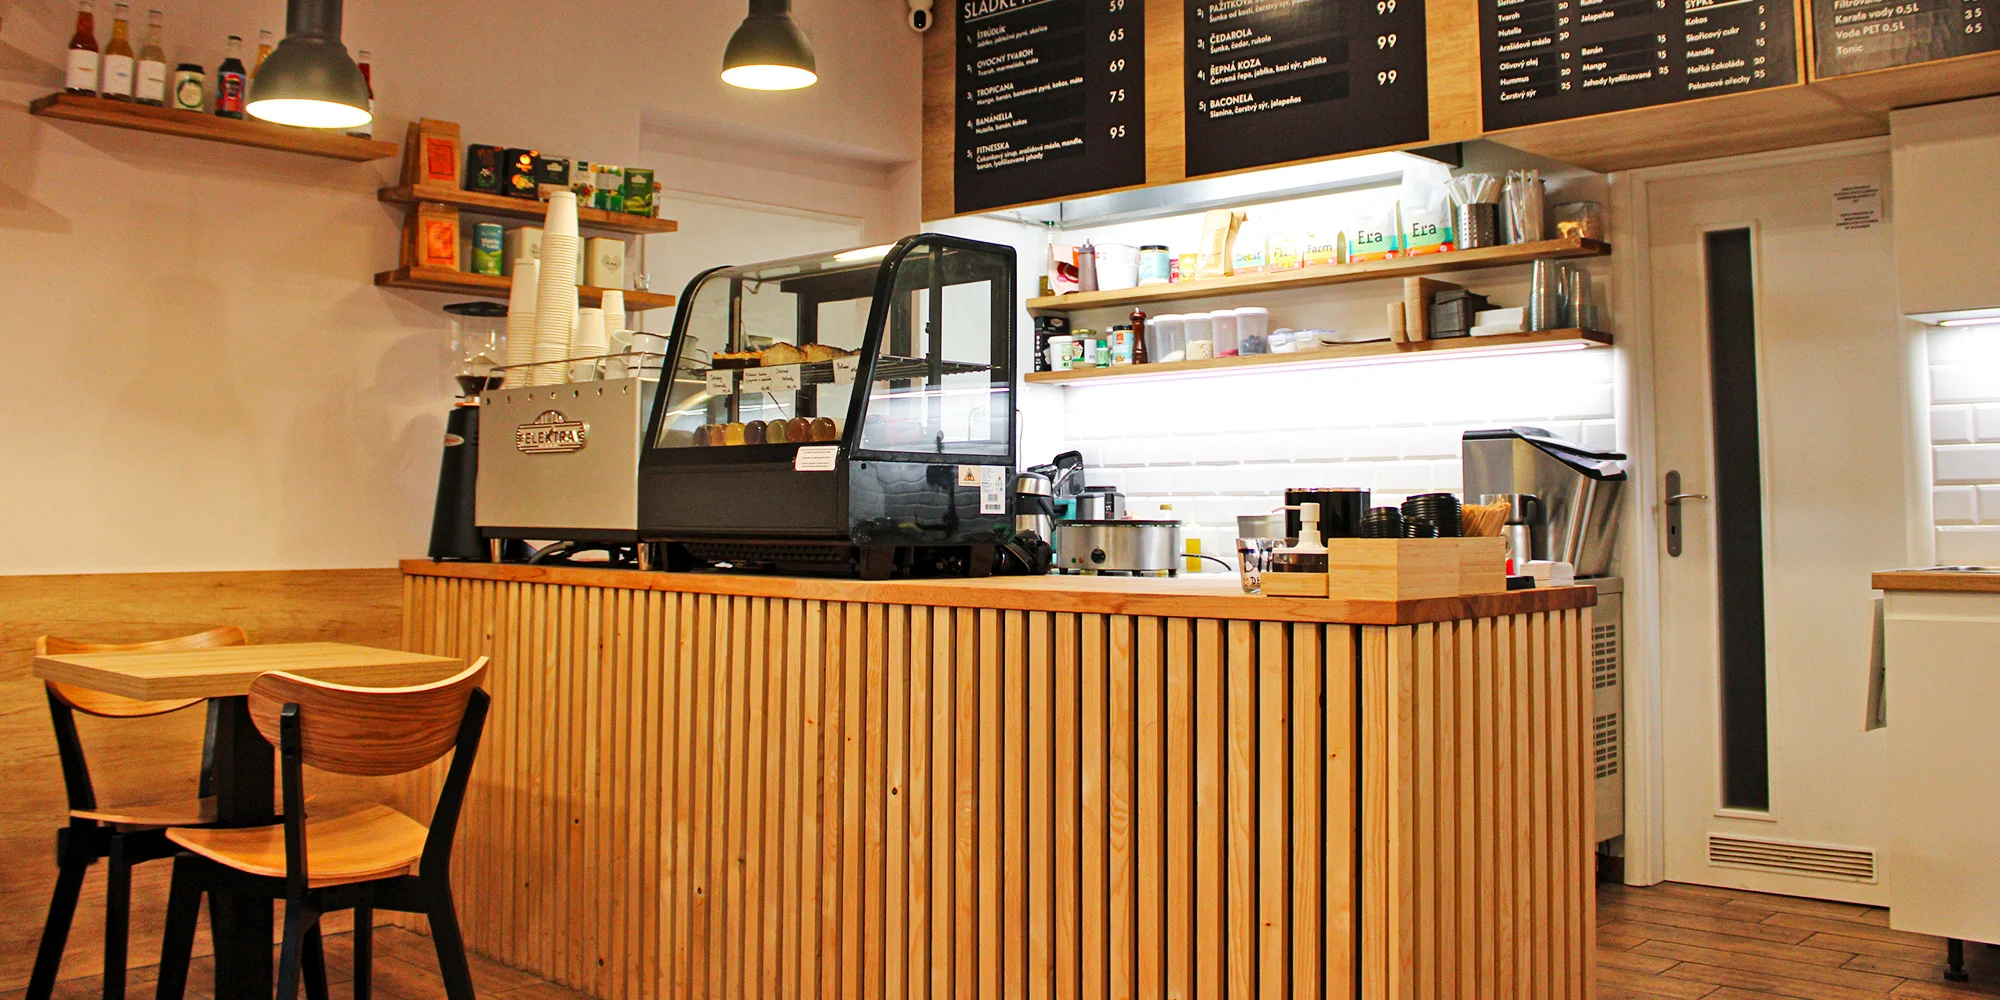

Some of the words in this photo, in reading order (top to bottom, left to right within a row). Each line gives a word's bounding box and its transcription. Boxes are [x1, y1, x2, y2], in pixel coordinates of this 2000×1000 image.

[1109, 0, 1125, 12] 59
[1376, 0, 1396, 15] 99
[1558, 1, 1569, 10] 20
[1656, 0, 1666, 9] 15
[1758, 5, 1765, 15] 5
[1209, 13, 1228, 23] Šunka
[1228, 10, 1237, 18] od
[1238, 7, 1254, 16] kosti,
[1497, 12, 1520, 22] Tvaroh
[1835, 11, 1867, 25] Karafa
[1868, 6, 1894, 18] vody
[1964, 7, 1983, 20] 35
[1558, 16, 1569, 27] 30
[1685, 16, 1709, 26] Kokos
[1760, 21, 1767, 31] 5
[1109, 28, 1125, 42] 65
[1498, 26, 1522, 37] Nutella
[1686, 29, 1722, 43] Skořicový
[1722, 26, 1740, 36] cukr
[1836, 28, 1861, 40] Voda
[1862, 24, 1880, 35] PET
[1964, 23, 1983, 34] 65
[1210, 27, 1253, 45] ČEDAROLA
[1377, 33, 1397, 50] 99
[1559, 31, 1570, 41] 30
[1657, 34, 1667, 44] 15
[1755, 37, 1766, 47] 15
[1210, 44, 1230, 54] Šunka,
[1231, 40, 1251, 50] čedar,
[1251, 34, 1272, 45] rukola
[1499, 40, 1531, 52] Arašídové
[1531, 37, 1552, 46] máslo
[1581, 45, 1604, 56] Banán
[1836, 44, 1864, 56] Tonic
[1007, 48, 1034, 61] TVAROH
[1560, 52, 1571, 60] 10
[1657, 50, 1667, 60] 15
[1686, 47, 1715, 59] Mandle
[1109, 58, 1125, 73] 69
[1210, 60, 1236, 76] ŘEPNÁ
[1237, 58, 1261, 70] KOZA
[1499, 60, 1525, 71] Olivový
[1526, 57, 1539, 67] olej
[1582, 62, 1607, 72] Mango
[1711, 59, 1745, 70] čokoláda
[1753, 56, 1766, 66] 20
[1210, 74, 1236, 86] Červená
[1237, 71, 1253, 81] řepa,
[1302, 56, 1327, 68] pažitka
[1560, 68, 1572, 77] 20
[1658, 65, 1670, 75] 25
[1754, 69, 1766, 78] 25
[1377, 69, 1397, 86] 99
[1500, 76, 1530, 86] Hummus
[1583, 76, 1608, 88] Jahody
[1608, 69, 1652, 85] lyofilizované
[1688, 78, 1724, 90] Pekanové
[1724, 75, 1751, 85] ořechy
[976, 82, 1014, 97] TROPICANA
[1561, 81, 1572, 90] 25
[1109, 88, 1125, 104] 75
[1210, 93, 1254, 109] BACONELA
[1500, 90, 1526, 102] Čerstvý
[1526, 88, 1537, 98] sýr
[1209, 108, 1234, 119] Slanina,
[1234, 103, 1258, 114] čerstvý
[1109, 125, 1126, 139] 95
[976, 141, 1010, 155] FITNESSKA
[1412, 222, 1437, 238] Era
[1357, 230, 1384, 245] Era
[1307, 243, 1333, 254] Farm
[1236, 250, 1261, 262] Decaf
[525, 428, 579, 445] ELEKTRA
